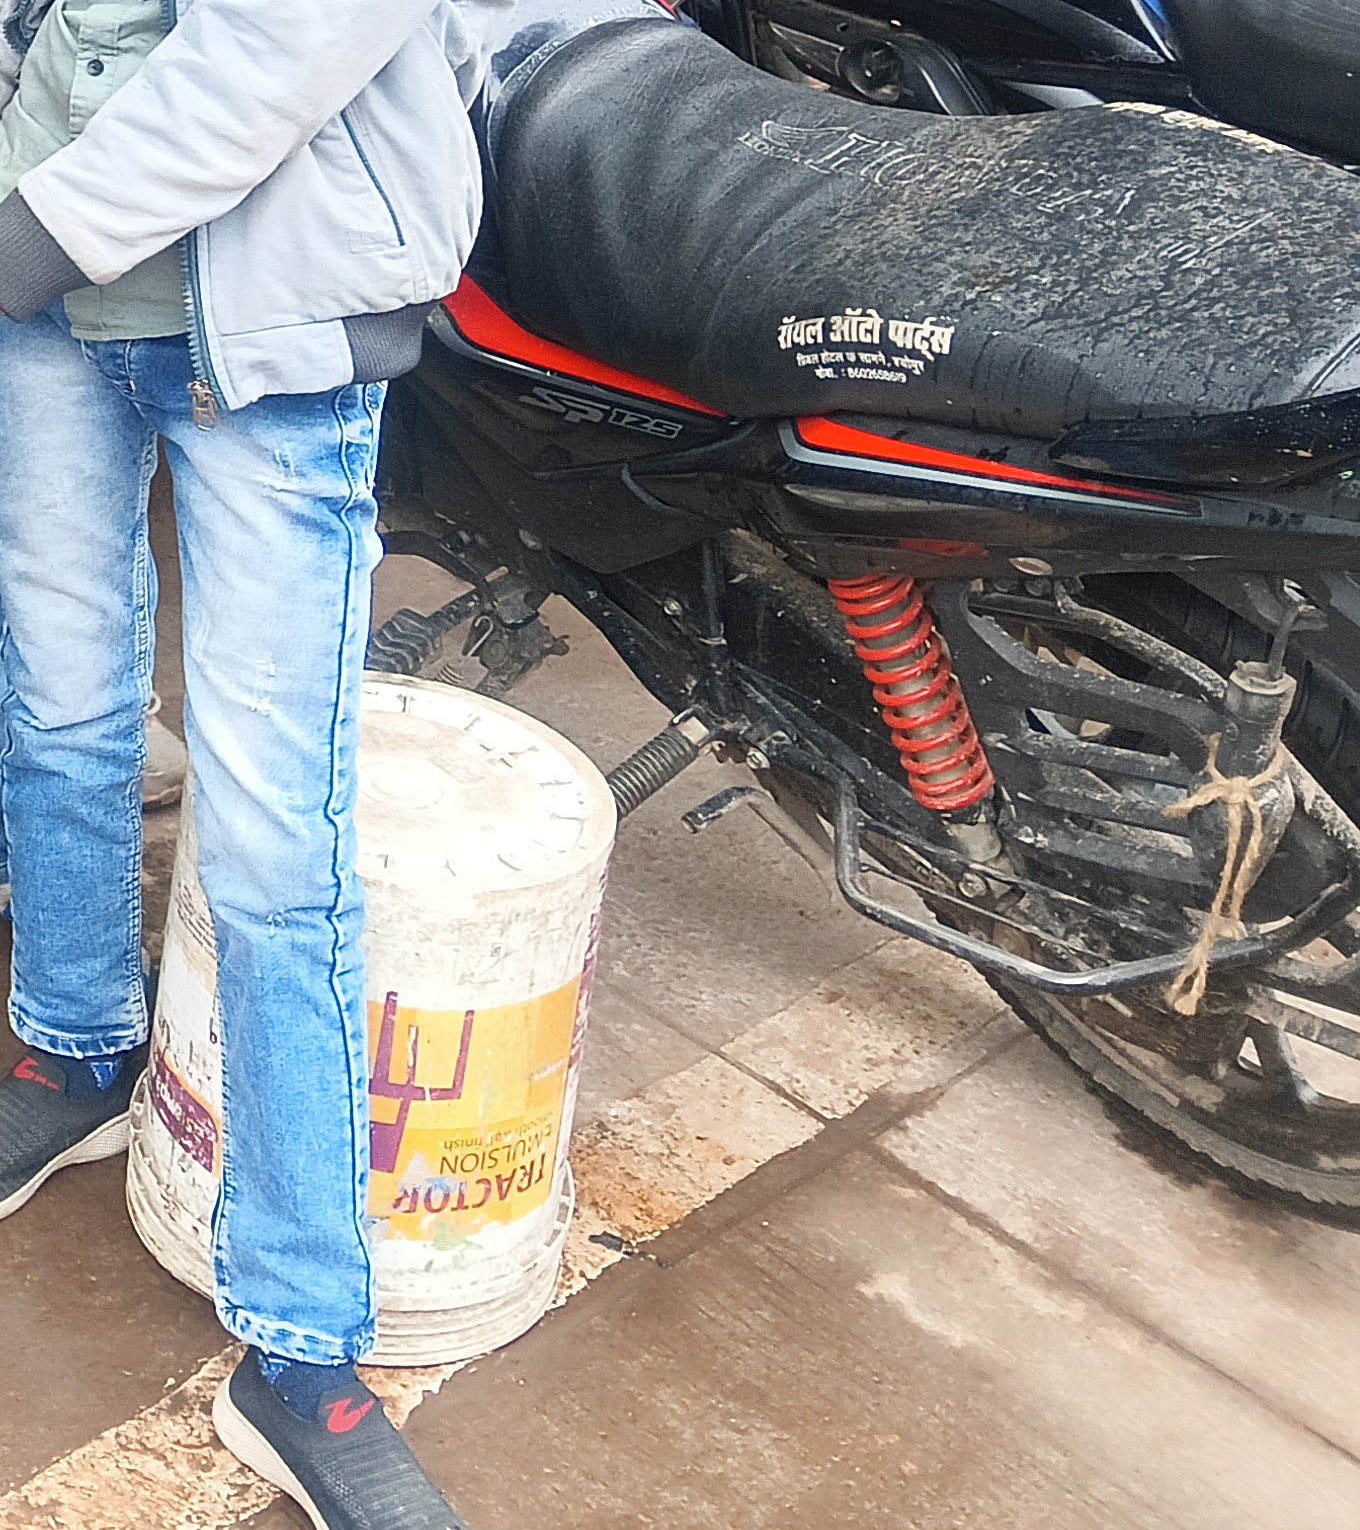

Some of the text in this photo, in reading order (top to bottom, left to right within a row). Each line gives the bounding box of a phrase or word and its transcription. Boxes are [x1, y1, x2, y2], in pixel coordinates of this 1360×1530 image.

[778, 315, 826, 350] रॉयल
[829, 307, 884, 345] ऑटो
[440, 1124, 553, 1175] EMULSION
[392, 1152, 546, 1213] TRACTOR
